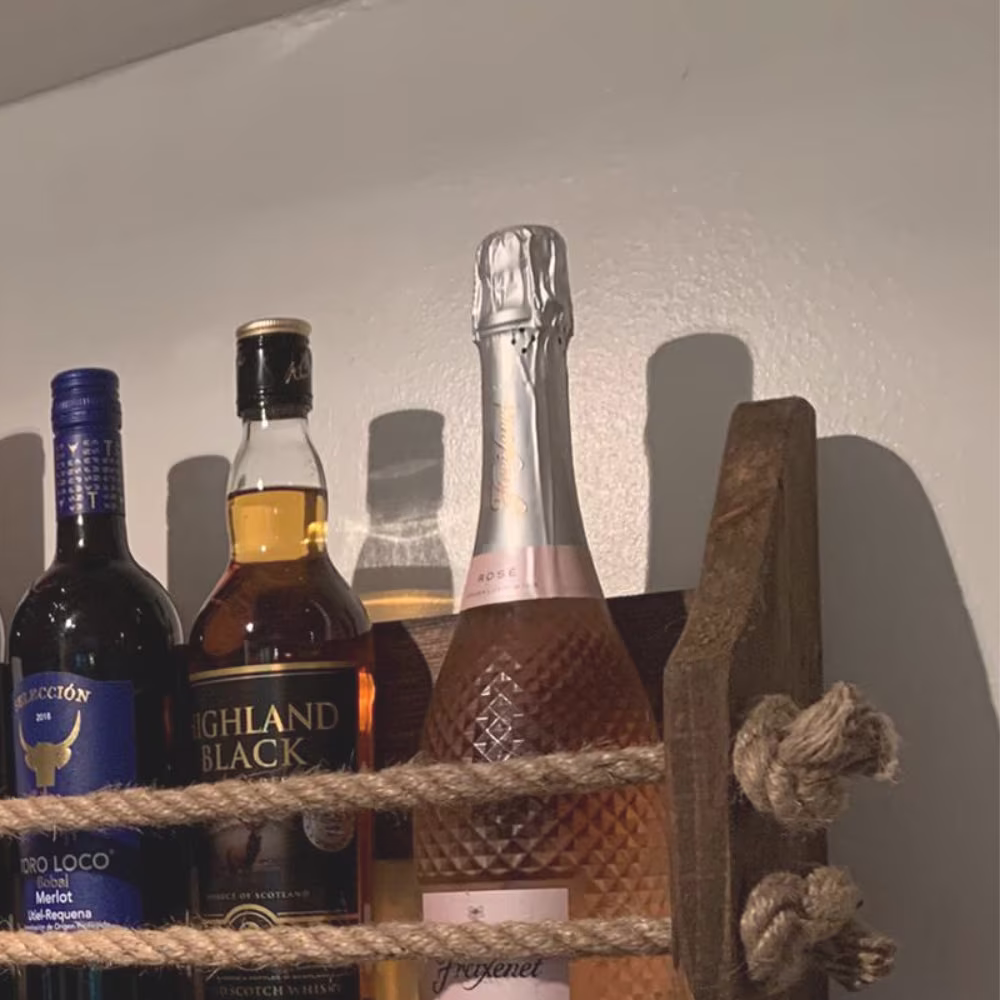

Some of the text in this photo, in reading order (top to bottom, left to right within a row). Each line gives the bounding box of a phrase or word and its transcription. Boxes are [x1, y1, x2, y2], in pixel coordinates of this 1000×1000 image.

[202, 737, 307, 772] BLACK
[53, 852, 109, 872] LOCO
[35, 890, 74, 904] Merlot
